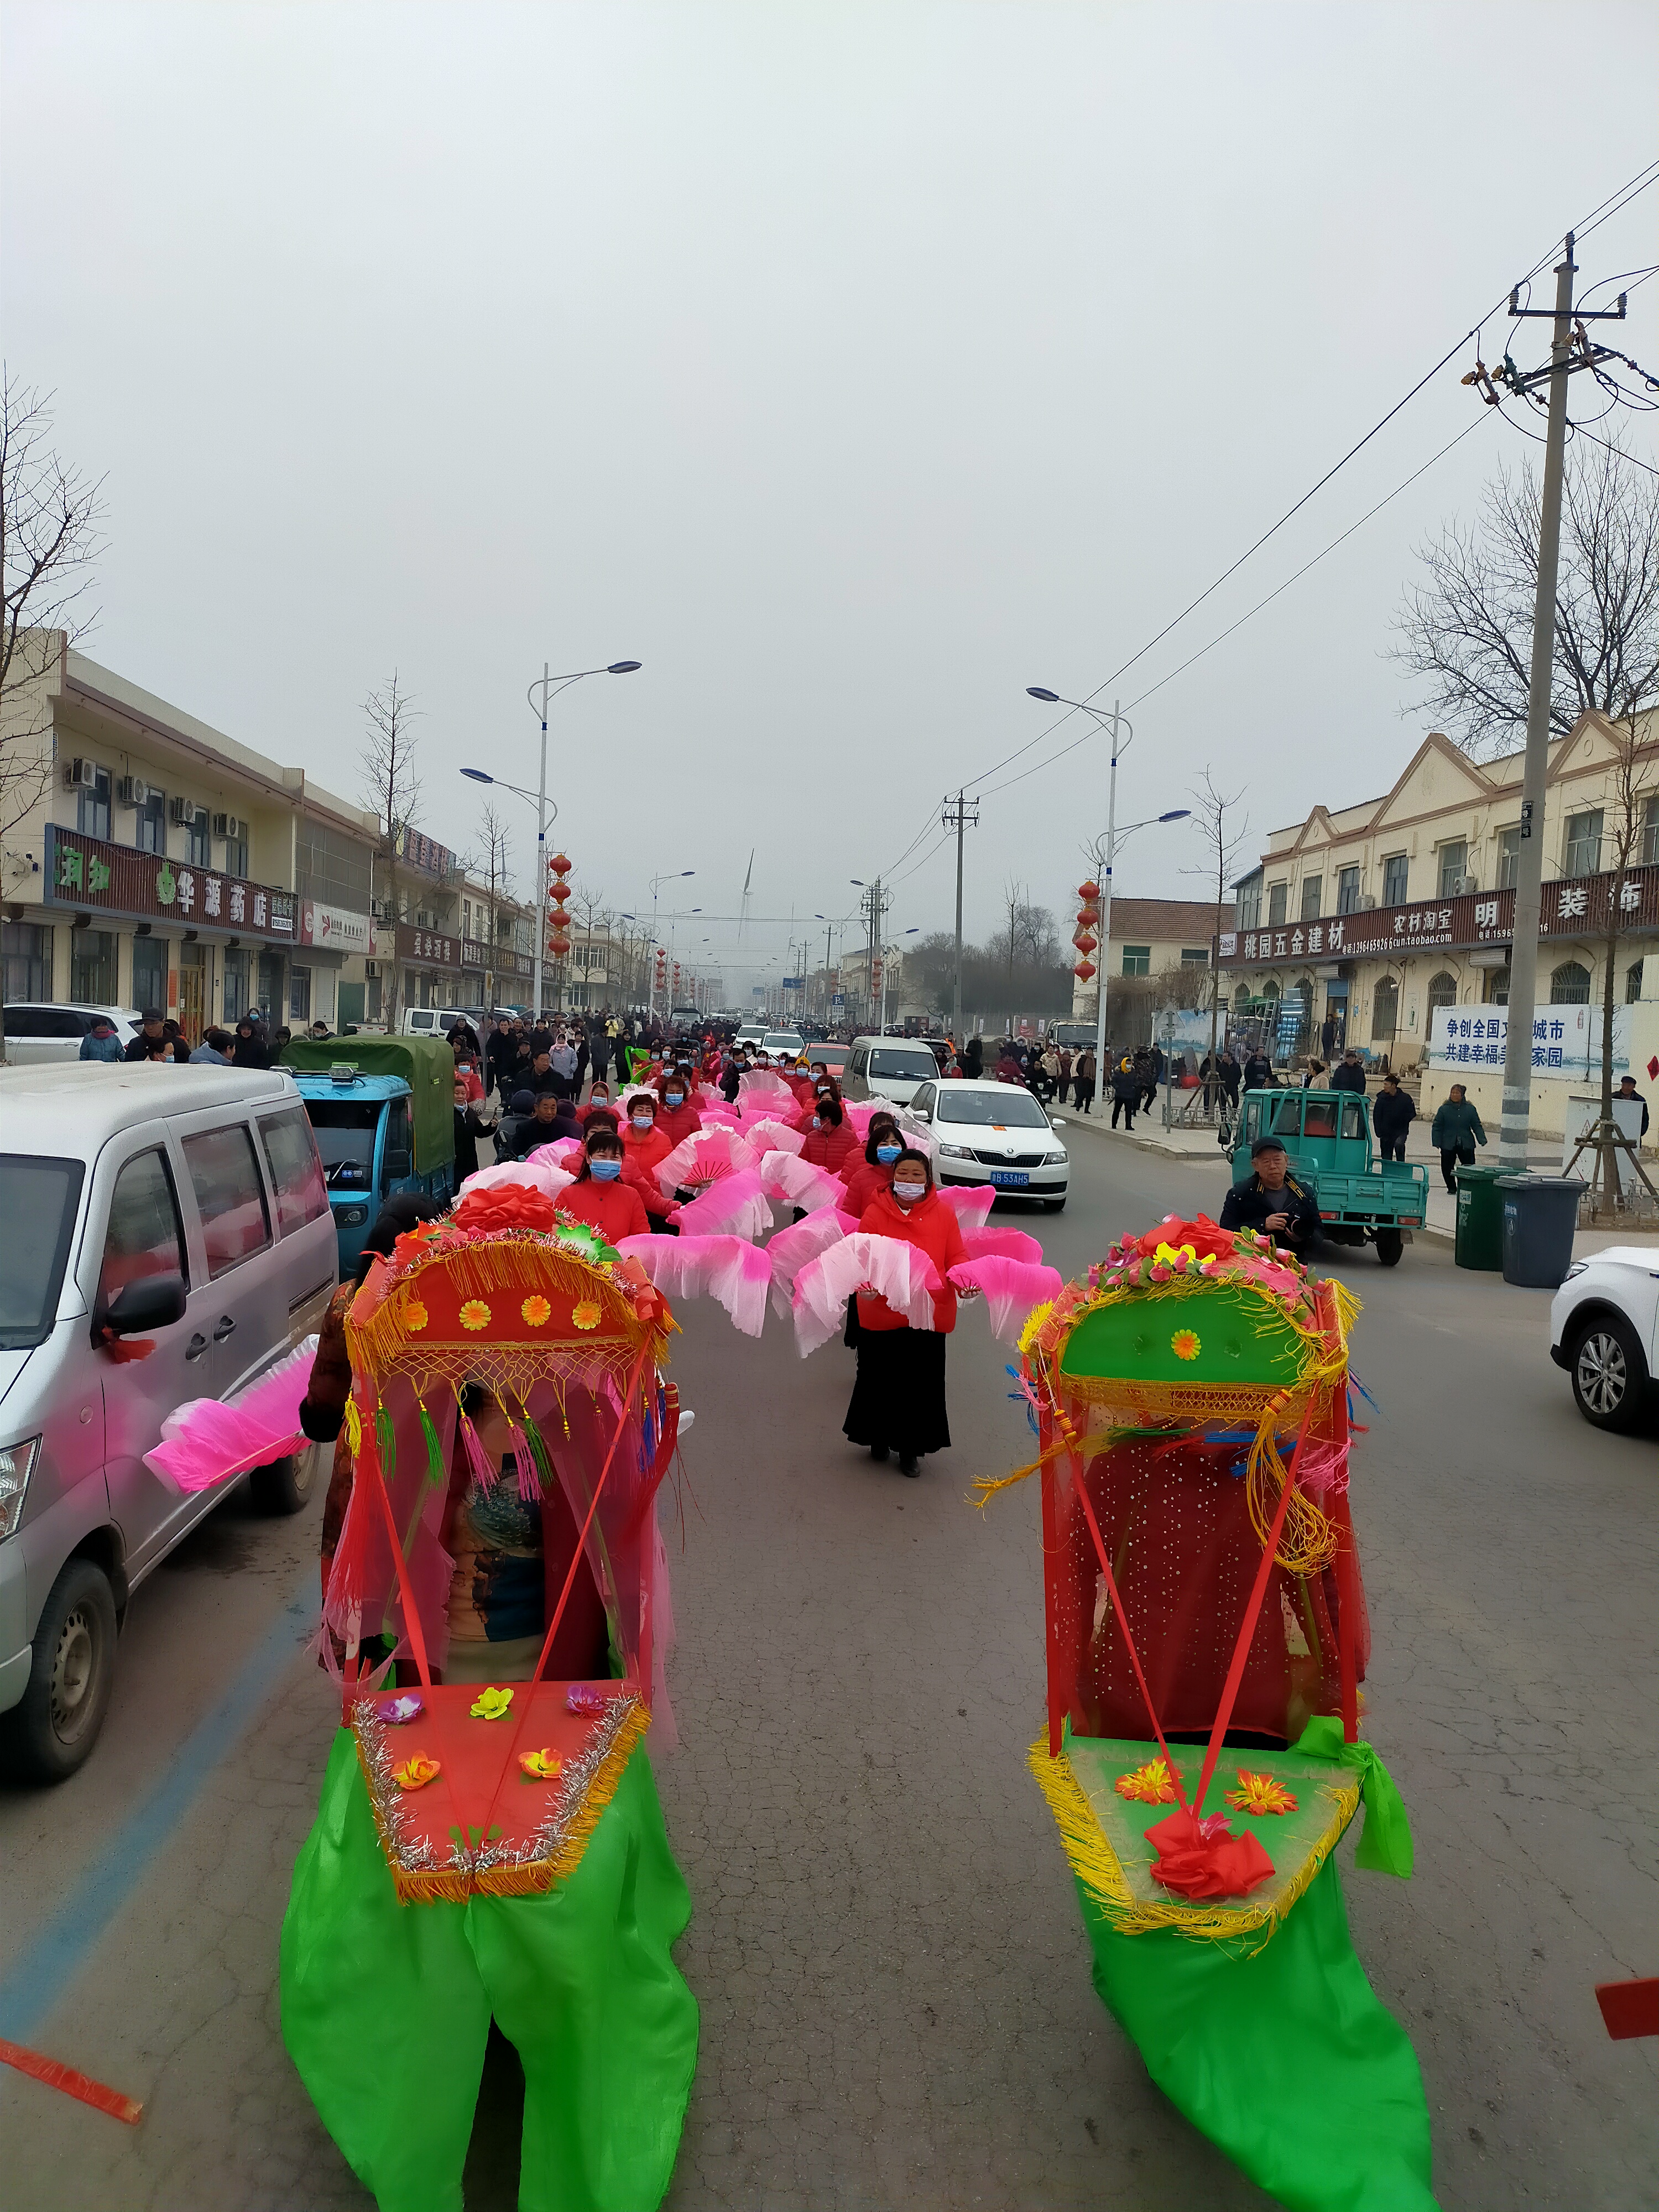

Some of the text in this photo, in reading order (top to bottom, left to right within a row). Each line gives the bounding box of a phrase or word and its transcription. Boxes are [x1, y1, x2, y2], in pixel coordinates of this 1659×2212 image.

[177, 870, 267, 927] 华源药店
[1475, 881, 1643, 928] 明装饰
[1393, 909, 1453, 934] 农村淘宝
[1244, 921, 1345, 959] 桃园五金建材
[1393, 933, 1452, 947] cun.taobao.com
[835, 997, 841, 1005] P
[1447, 1018, 1564, 1041] 争创全国城市
[1445, 1043, 1563, 1068] 共建幸福家园
